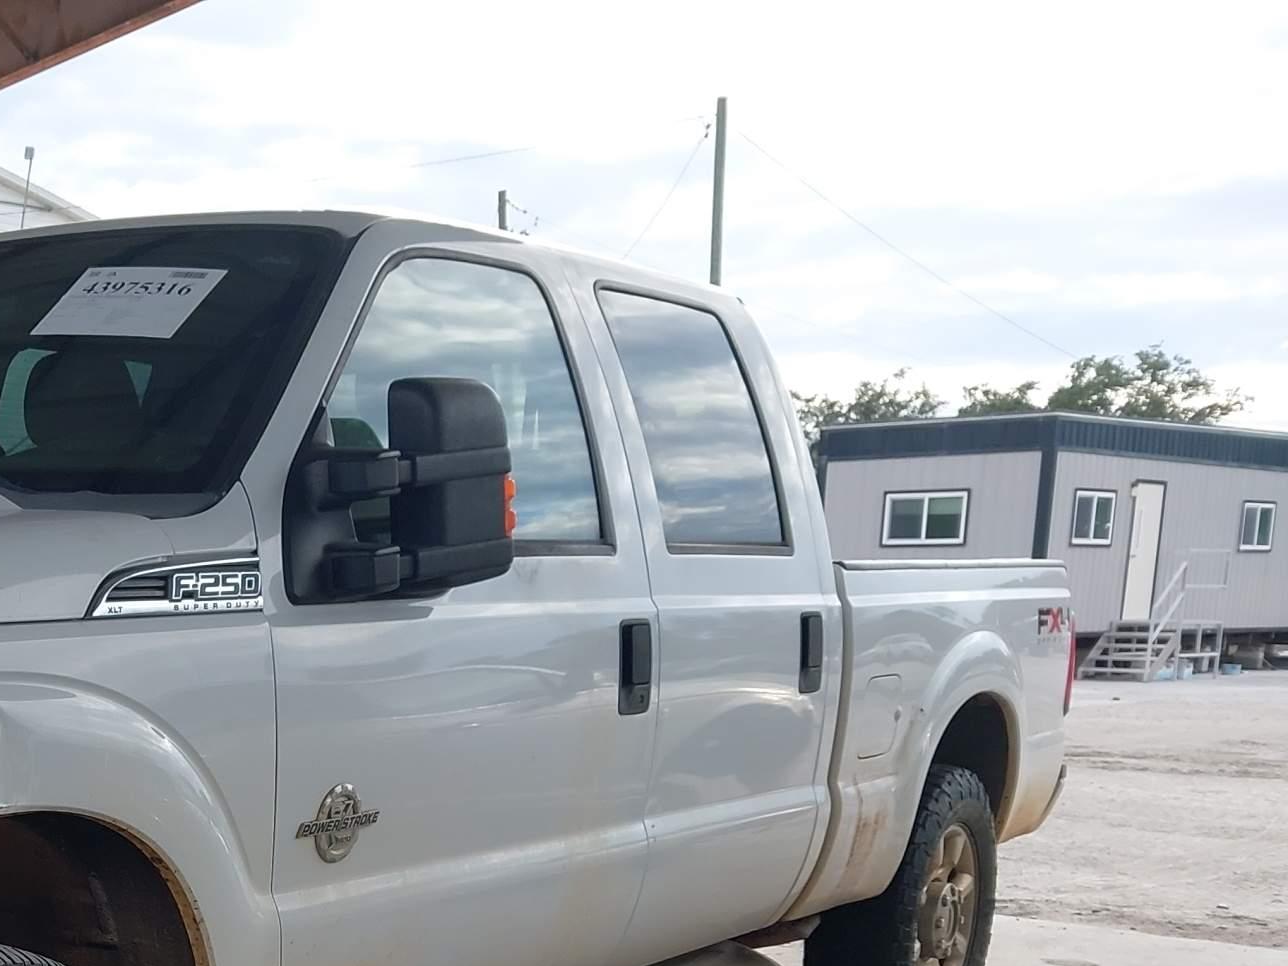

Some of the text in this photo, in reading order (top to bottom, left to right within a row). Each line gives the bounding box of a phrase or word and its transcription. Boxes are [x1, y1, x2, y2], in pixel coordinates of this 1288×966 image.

[82, 281, 192, 296] 43975316
[172, 572, 261, 600] F-250
[107, 606, 122, 614] XLT
[173, 601, 260, 611] SUPER DUTY
[303, 811, 379, 837] POWER STROKE
